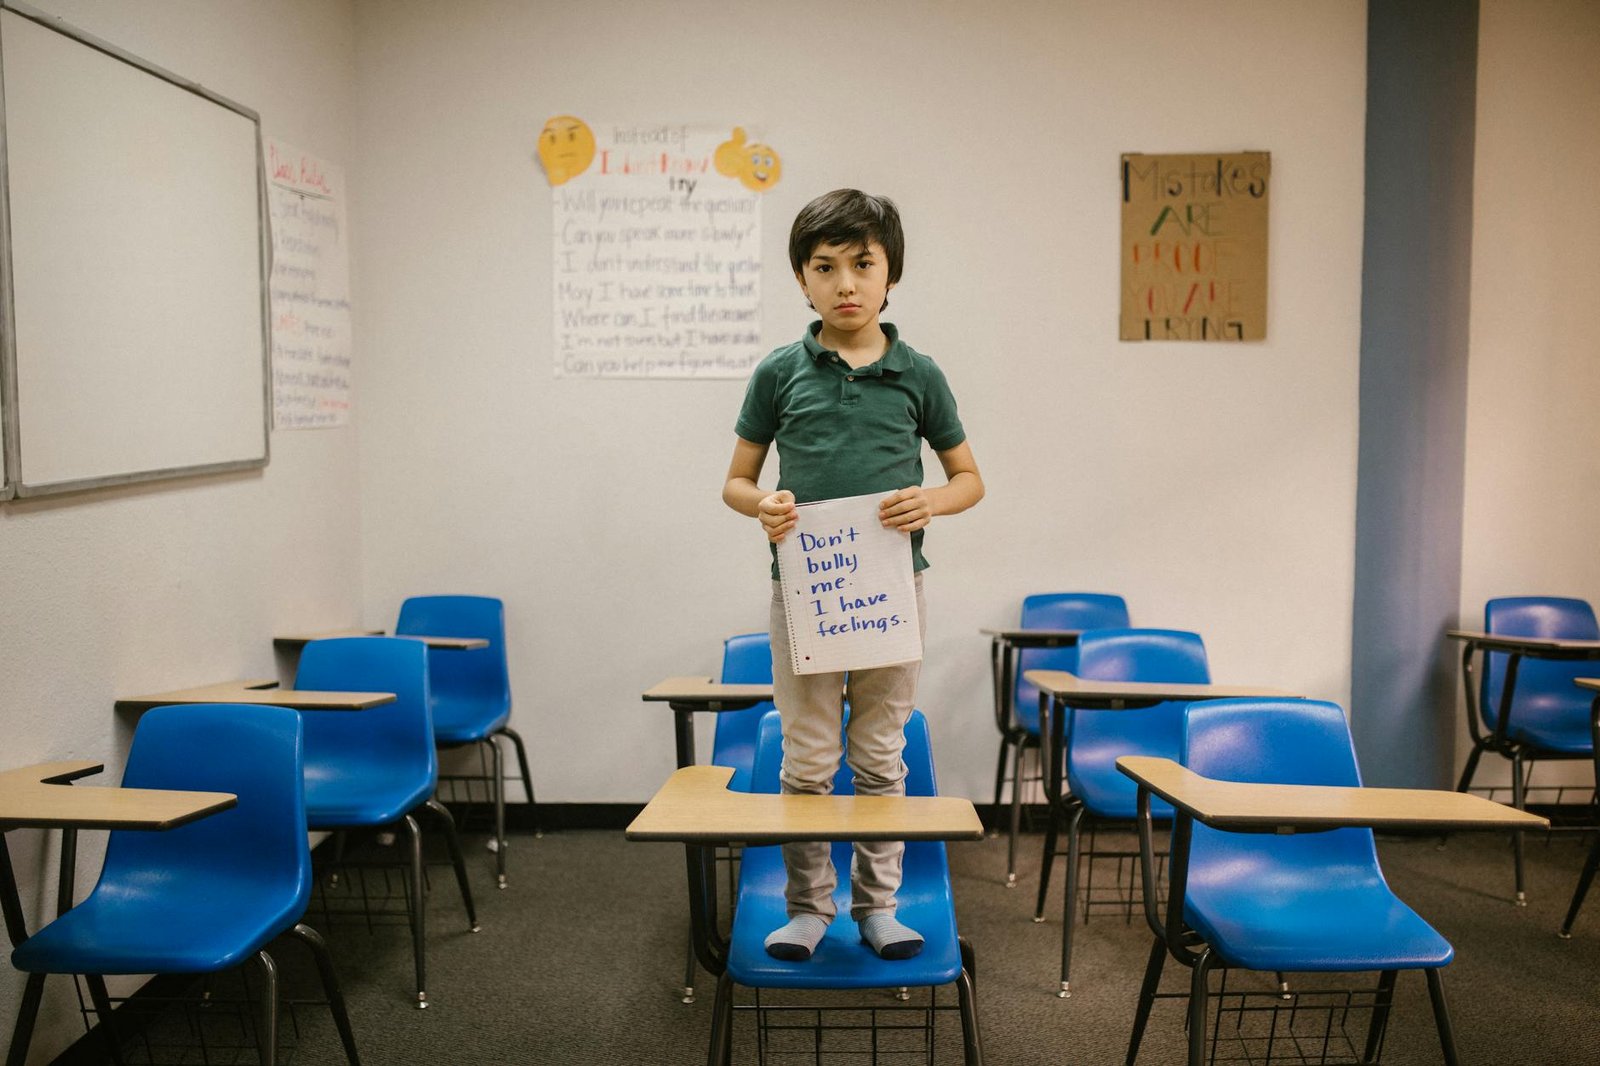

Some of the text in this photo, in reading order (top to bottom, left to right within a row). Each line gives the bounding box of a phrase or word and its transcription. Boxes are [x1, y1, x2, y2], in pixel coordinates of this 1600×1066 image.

[1121, 158, 1265, 203] Mistakes
[1150, 202, 1229, 237] ARE
[797, 527, 861, 552] Don't
[807, 553, 858, 574] bully
[811, 576, 853, 595] me.
[810, 592, 889, 617] I have
[816, 614, 907, 637] feelings.
